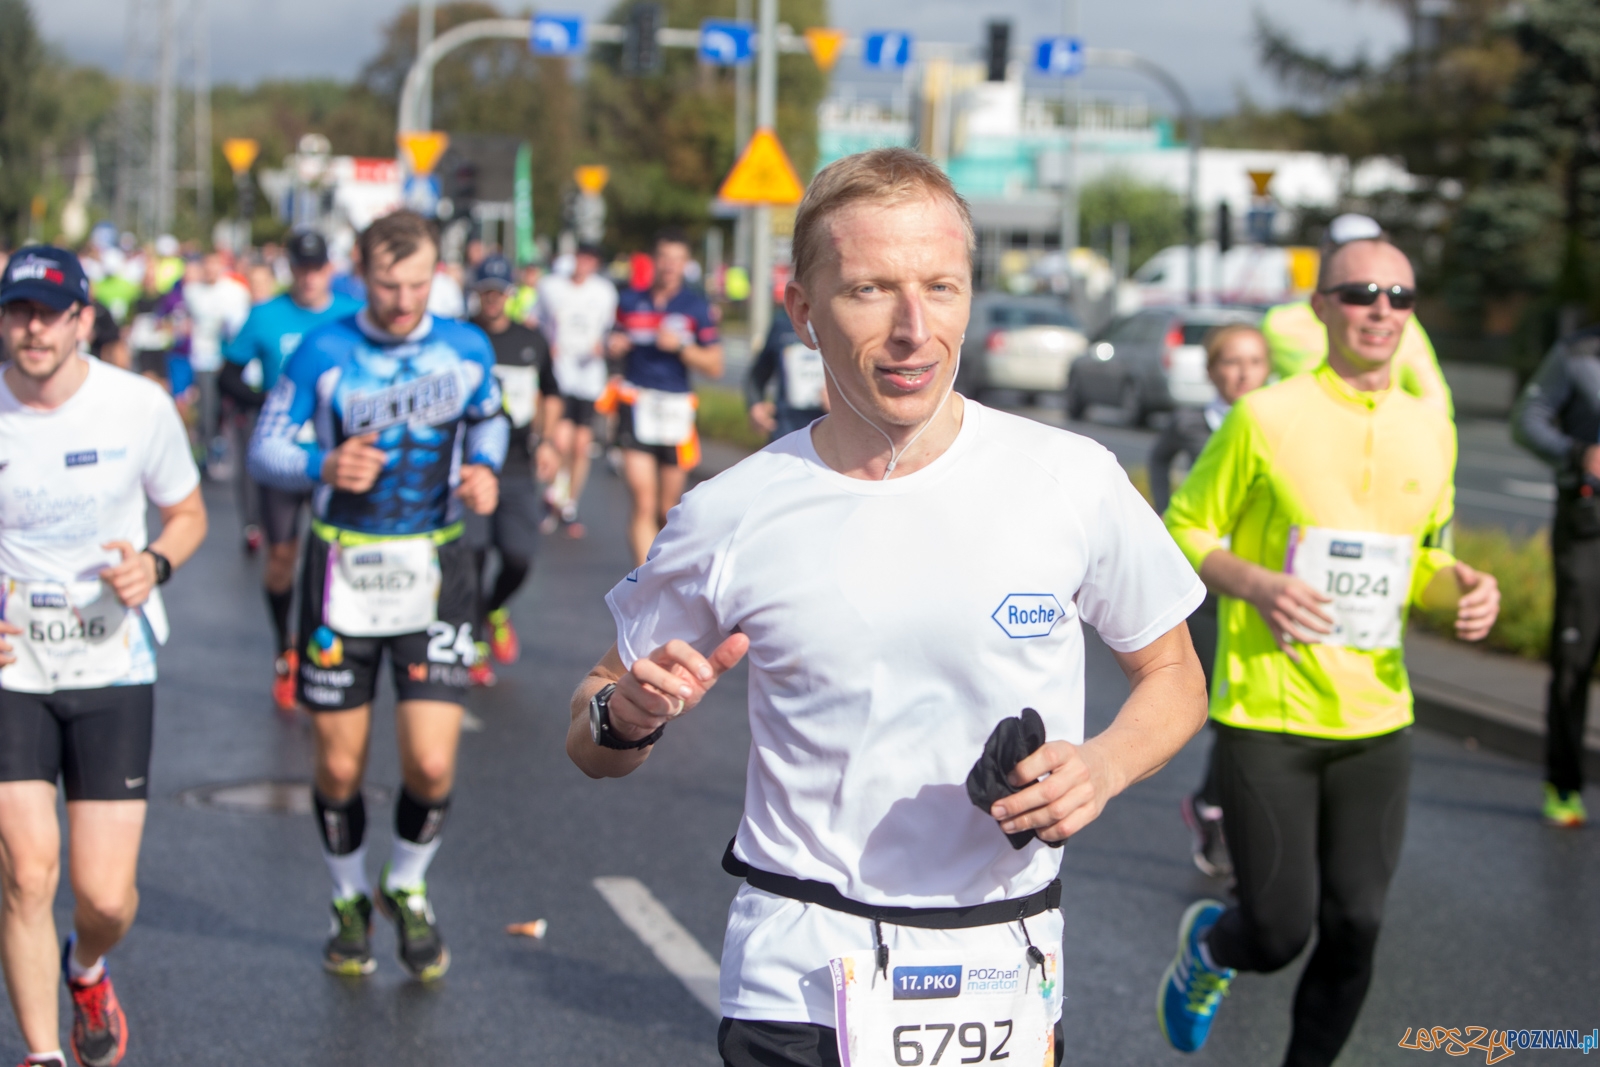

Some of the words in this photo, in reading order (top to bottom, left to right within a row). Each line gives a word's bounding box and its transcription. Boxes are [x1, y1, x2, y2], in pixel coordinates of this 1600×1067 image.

[1326, 571, 1389, 596] 1024
[1008, 604, 1055, 625] Roche
[427, 621, 476, 667] 24
[966, 979, 1019, 991] maraton
[892, 1018, 1013, 1067] 6792
